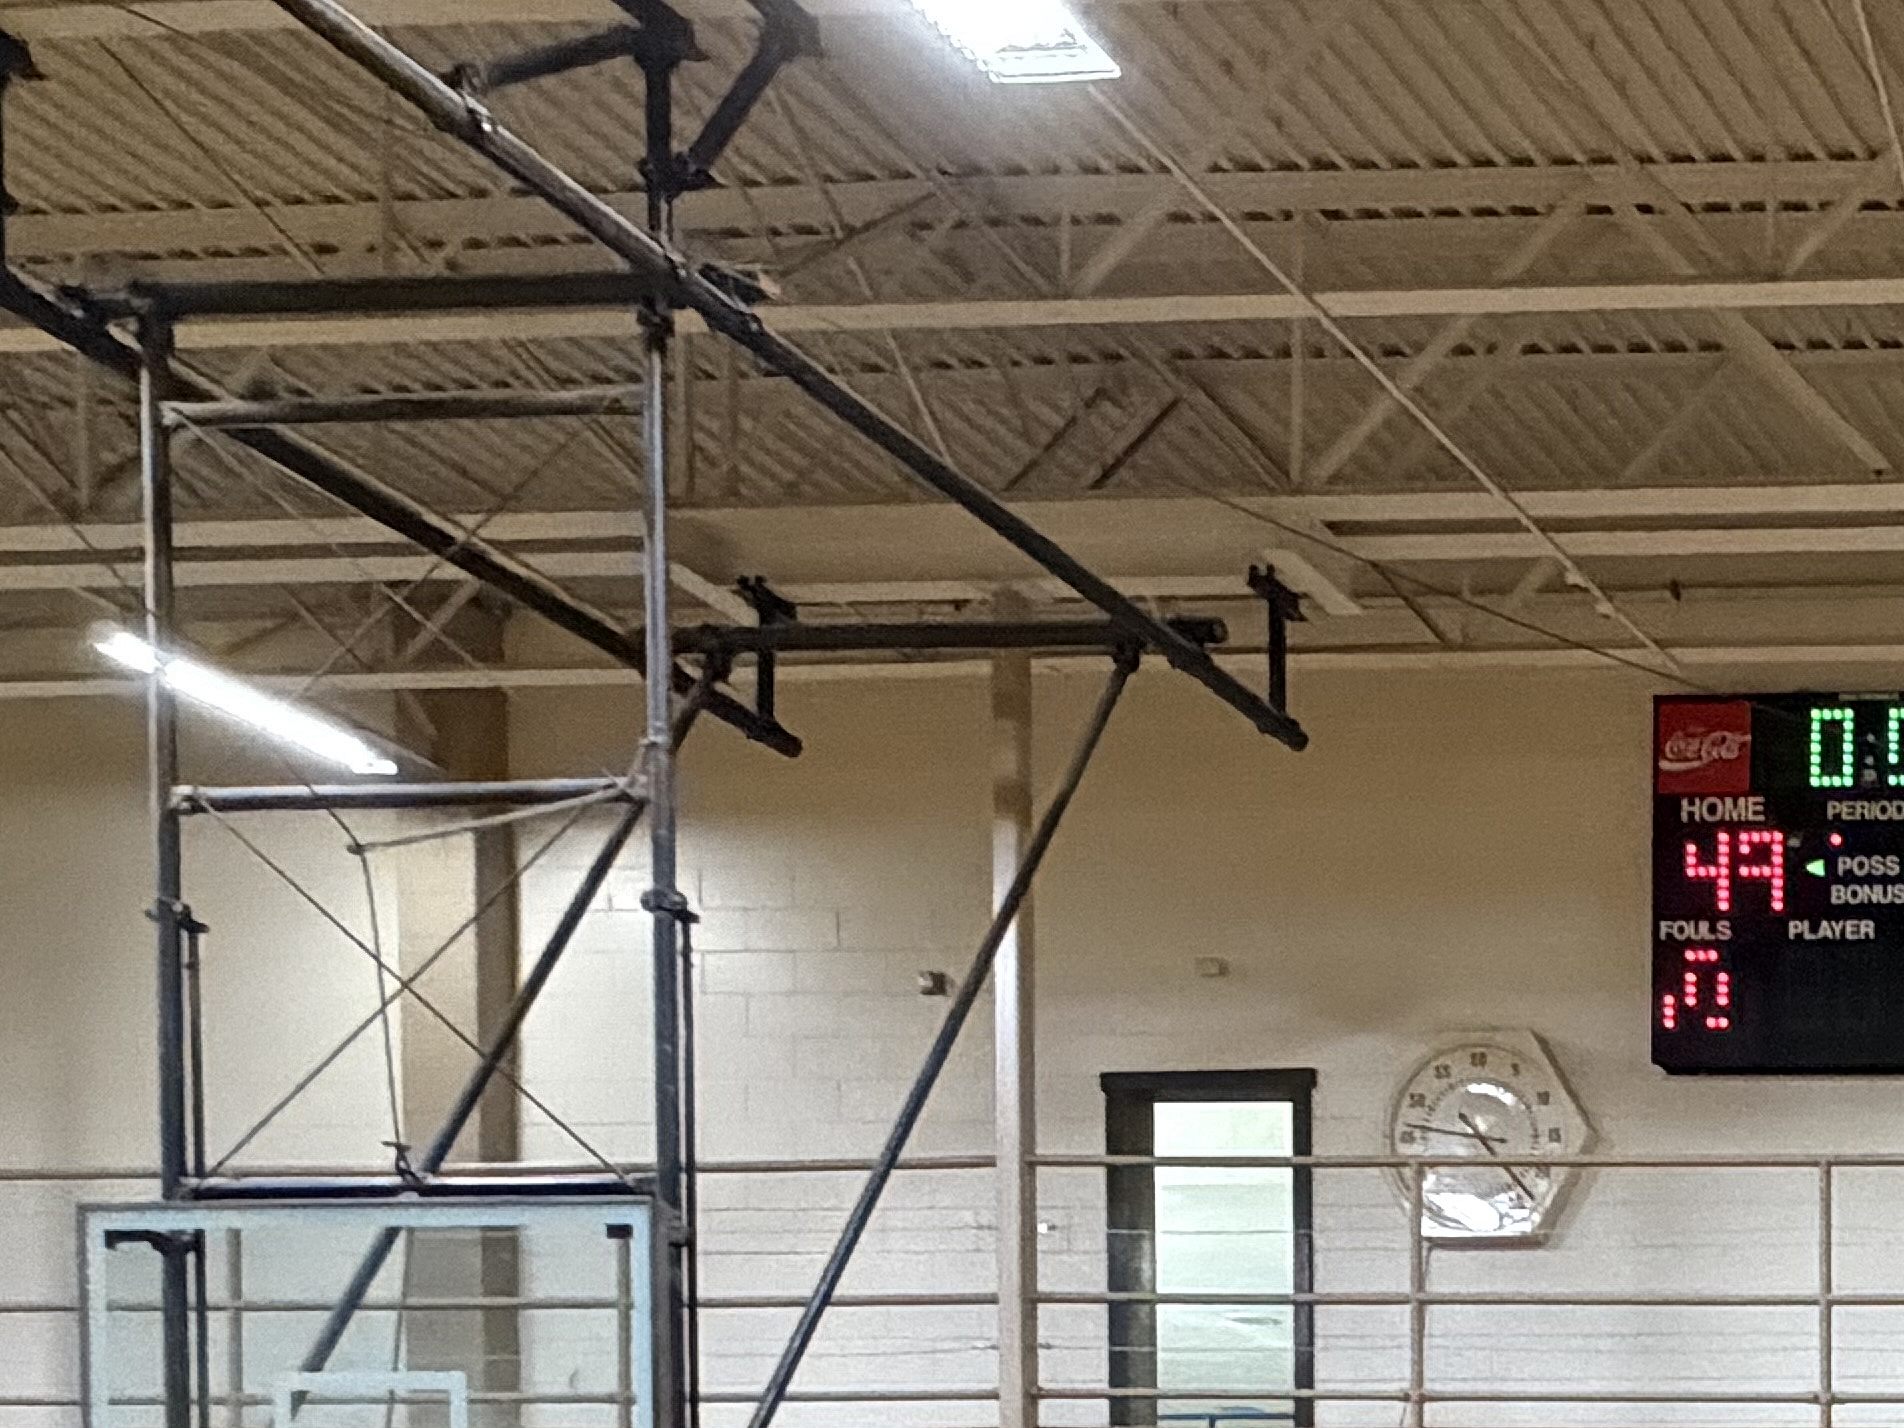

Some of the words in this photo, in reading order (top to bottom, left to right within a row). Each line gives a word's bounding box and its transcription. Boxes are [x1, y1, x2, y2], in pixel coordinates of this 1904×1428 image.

[1680, 796, 1765, 823] HOME
[1684, 829, 1784, 912] 49
[1837, 855, 1901, 877] POSS
[1659, 919, 1733, 941] FOULS
[1788, 919, 1876, 941] PLAYER
